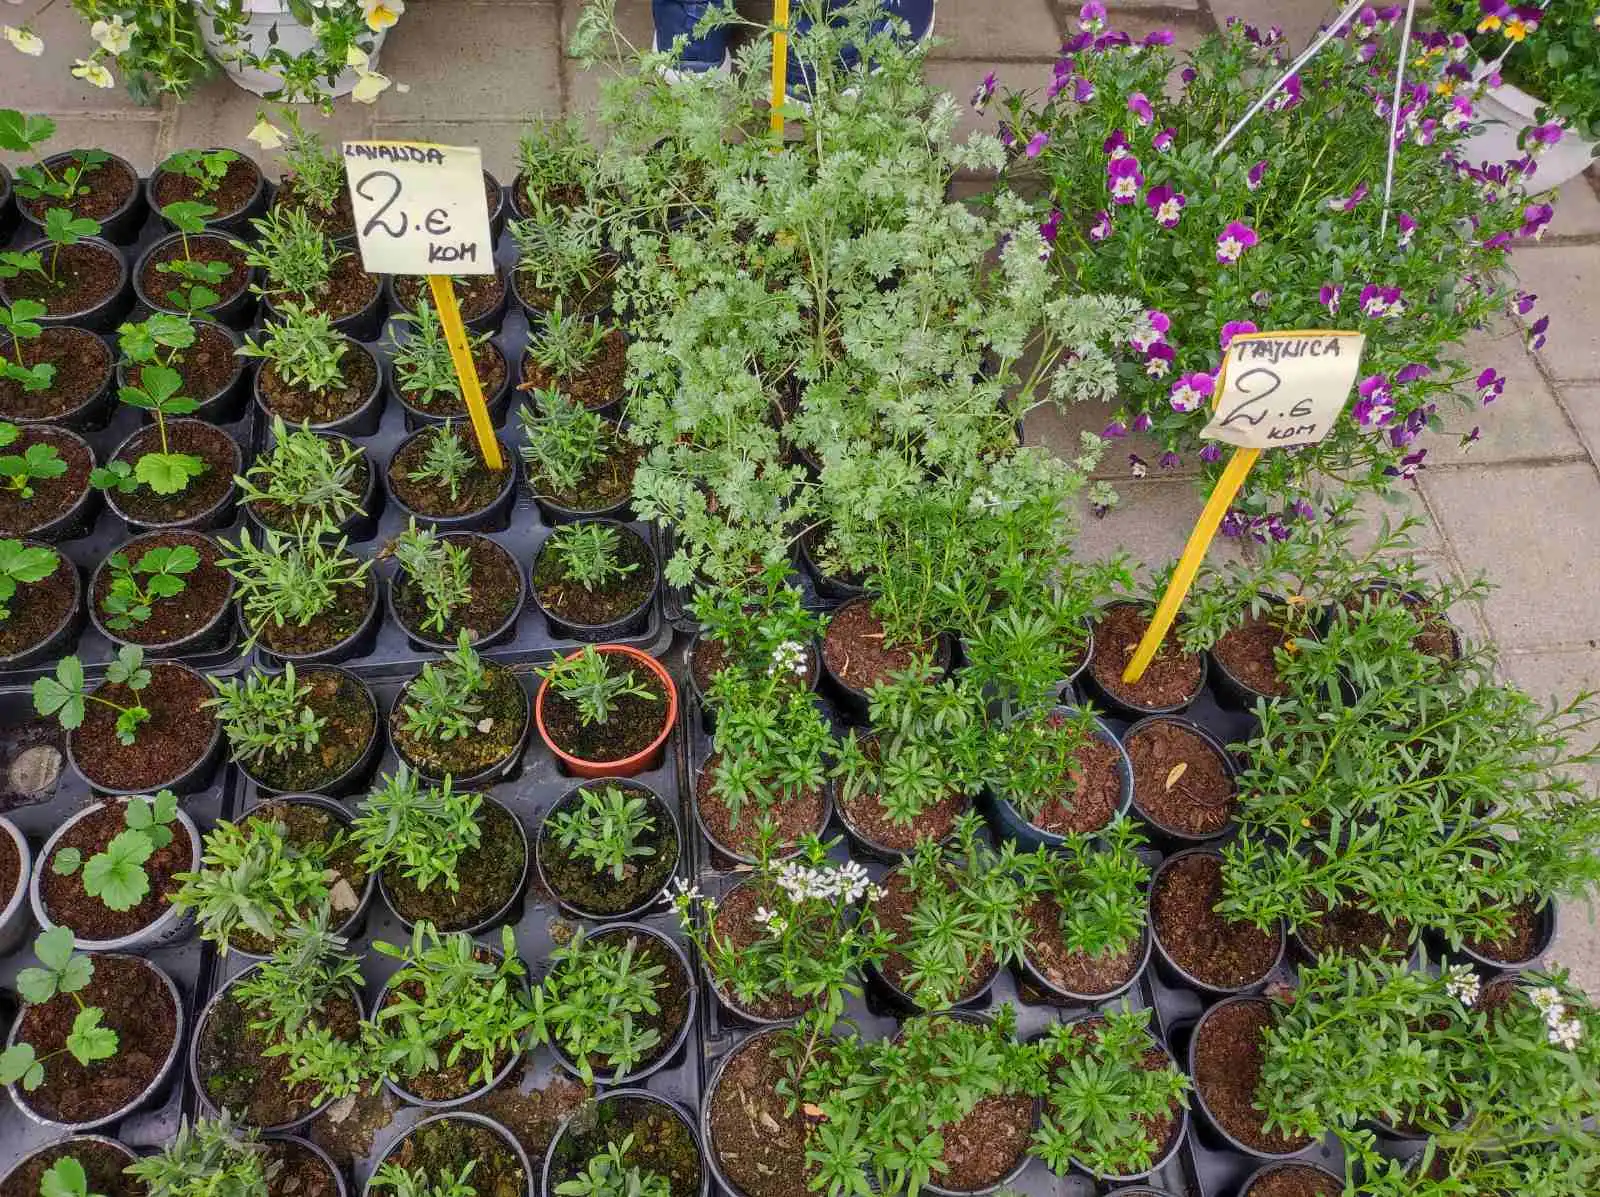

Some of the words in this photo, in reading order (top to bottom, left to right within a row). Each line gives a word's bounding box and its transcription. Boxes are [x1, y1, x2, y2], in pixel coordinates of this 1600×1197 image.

[345, 144, 446, 165] LAVANDA
[428, 242, 477, 263] KOM
[1233, 338, 1341, 364] TRAJNICA
[1267, 424, 1317, 439] KOM
